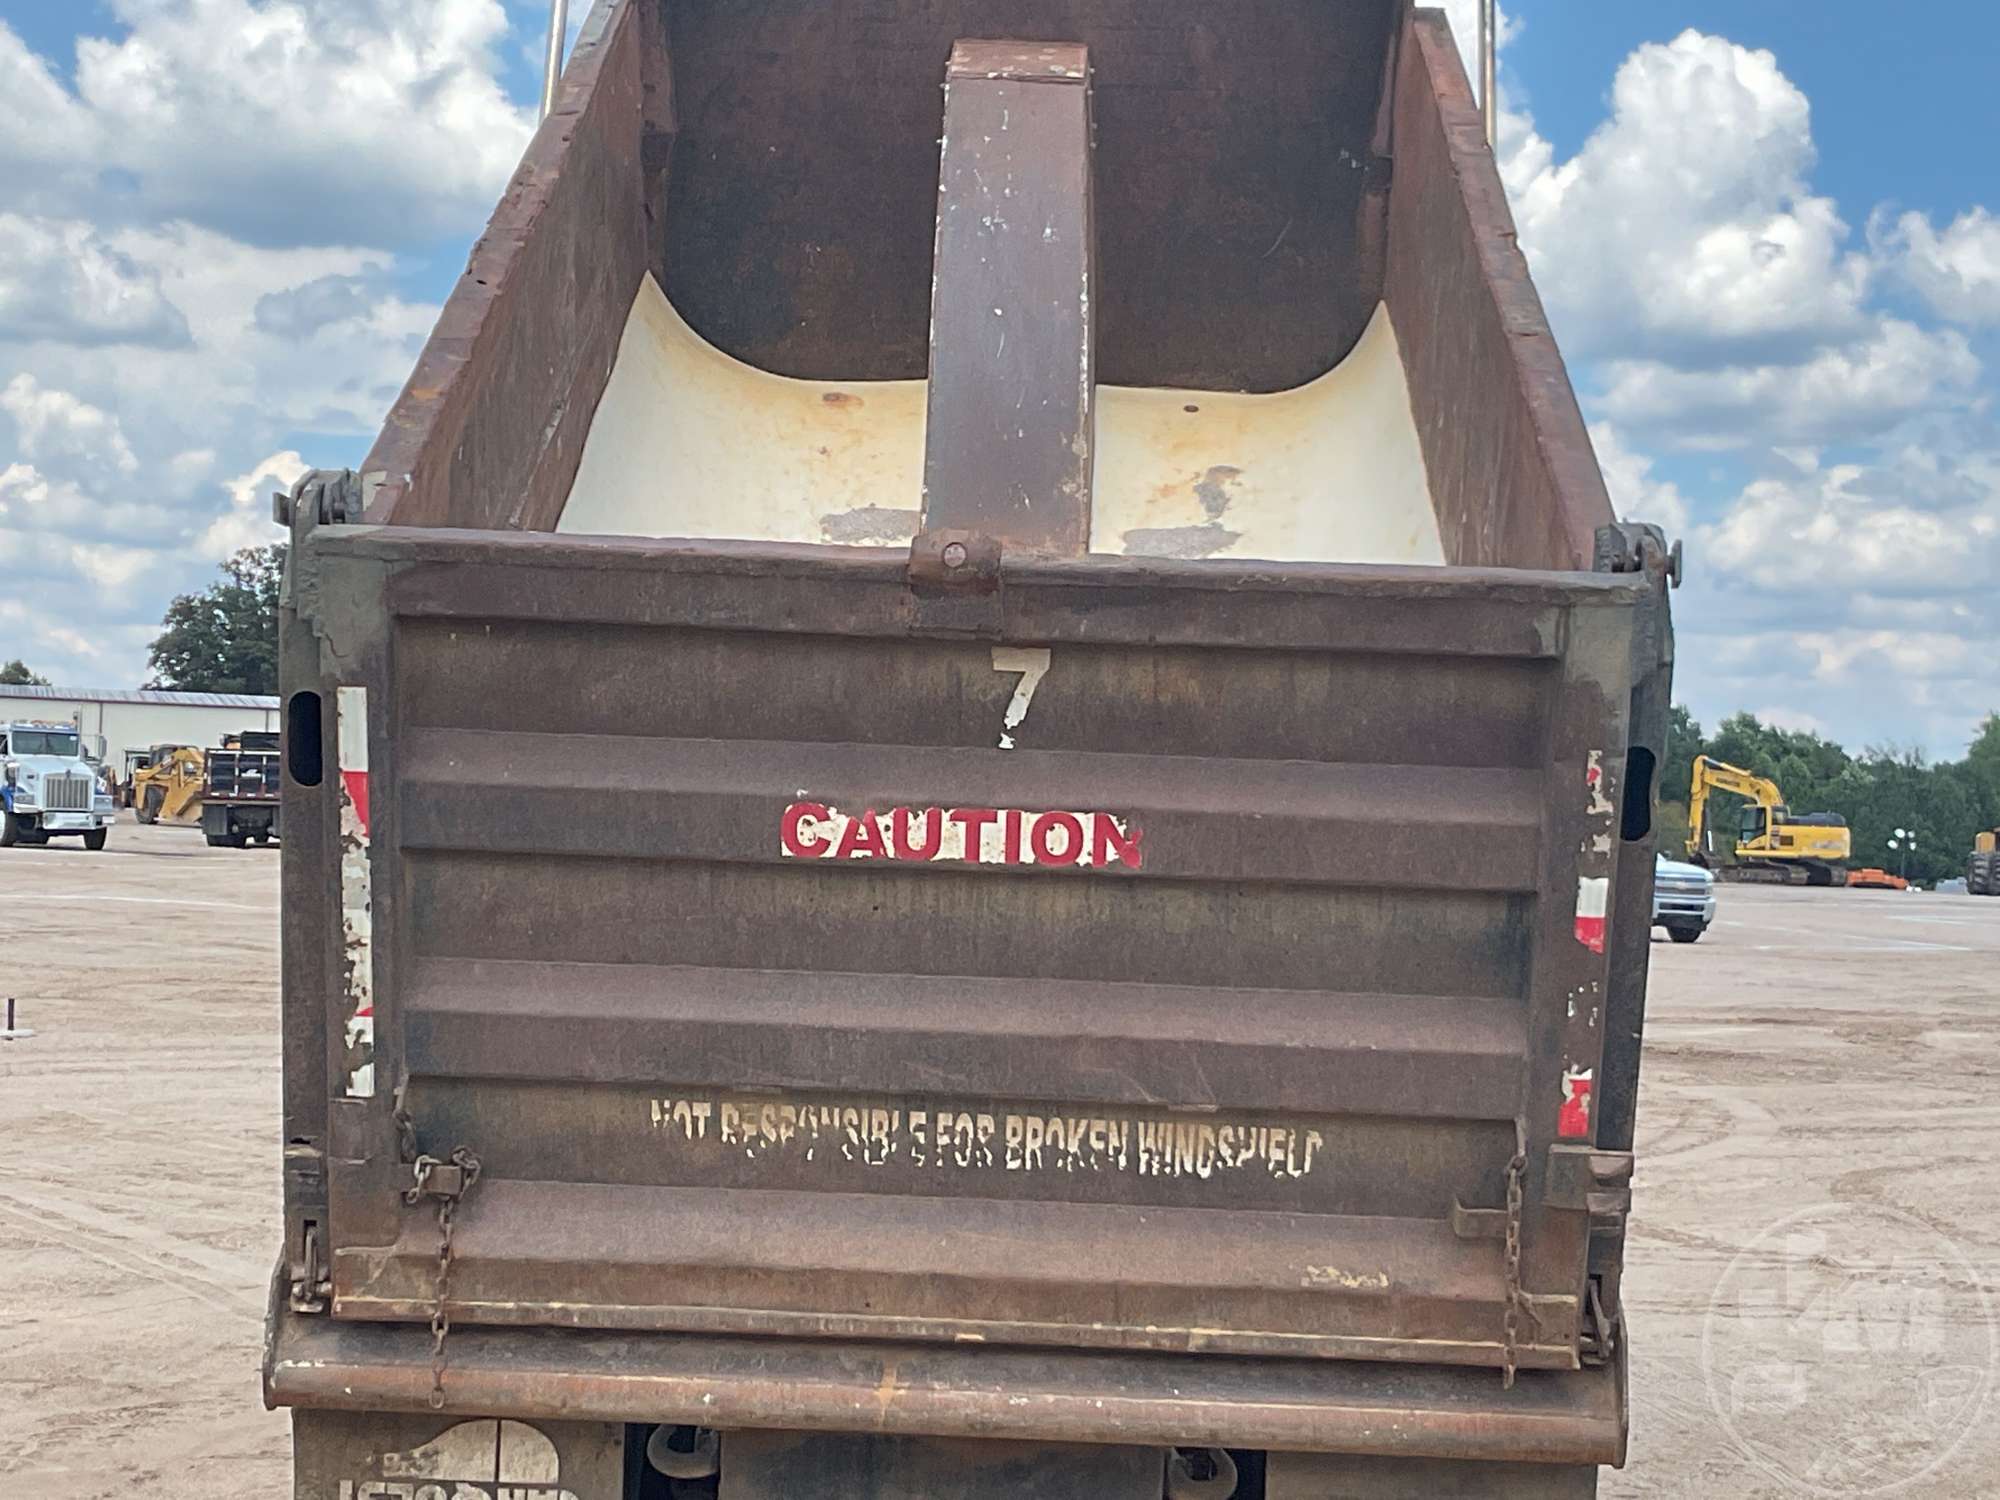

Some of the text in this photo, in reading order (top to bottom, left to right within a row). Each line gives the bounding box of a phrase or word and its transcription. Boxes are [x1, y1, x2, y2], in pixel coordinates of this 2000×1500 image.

[991, 648, 1050, 749] 7
[781, 802, 1142, 868] CAUTION
[937, 1112, 995, 1168] FOR
[1006, 1115, 1128, 1171] BROKEN
